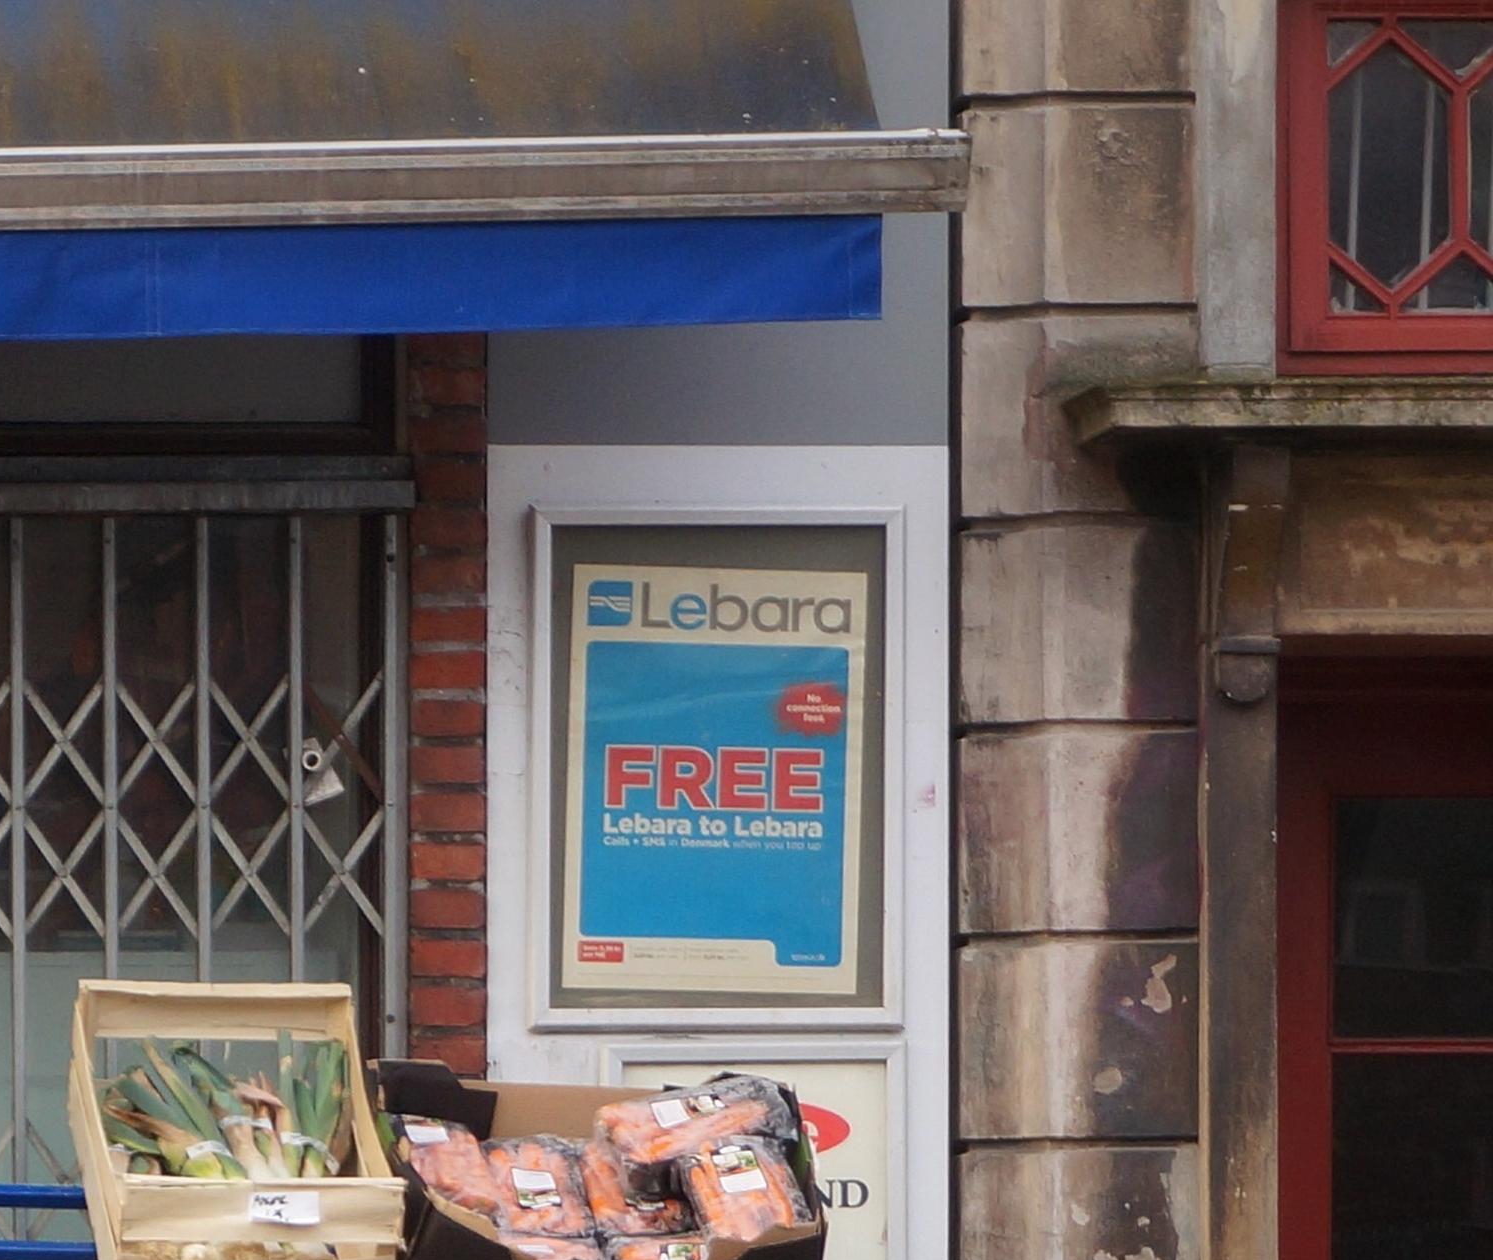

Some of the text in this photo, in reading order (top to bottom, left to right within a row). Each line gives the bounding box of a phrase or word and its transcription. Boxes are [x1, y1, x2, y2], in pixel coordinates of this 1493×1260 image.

[641, 581, 851, 633] Lebara
[603, 744, 823, 813] FREE
[603, 813, 823, 838] Lebara to Lebara
